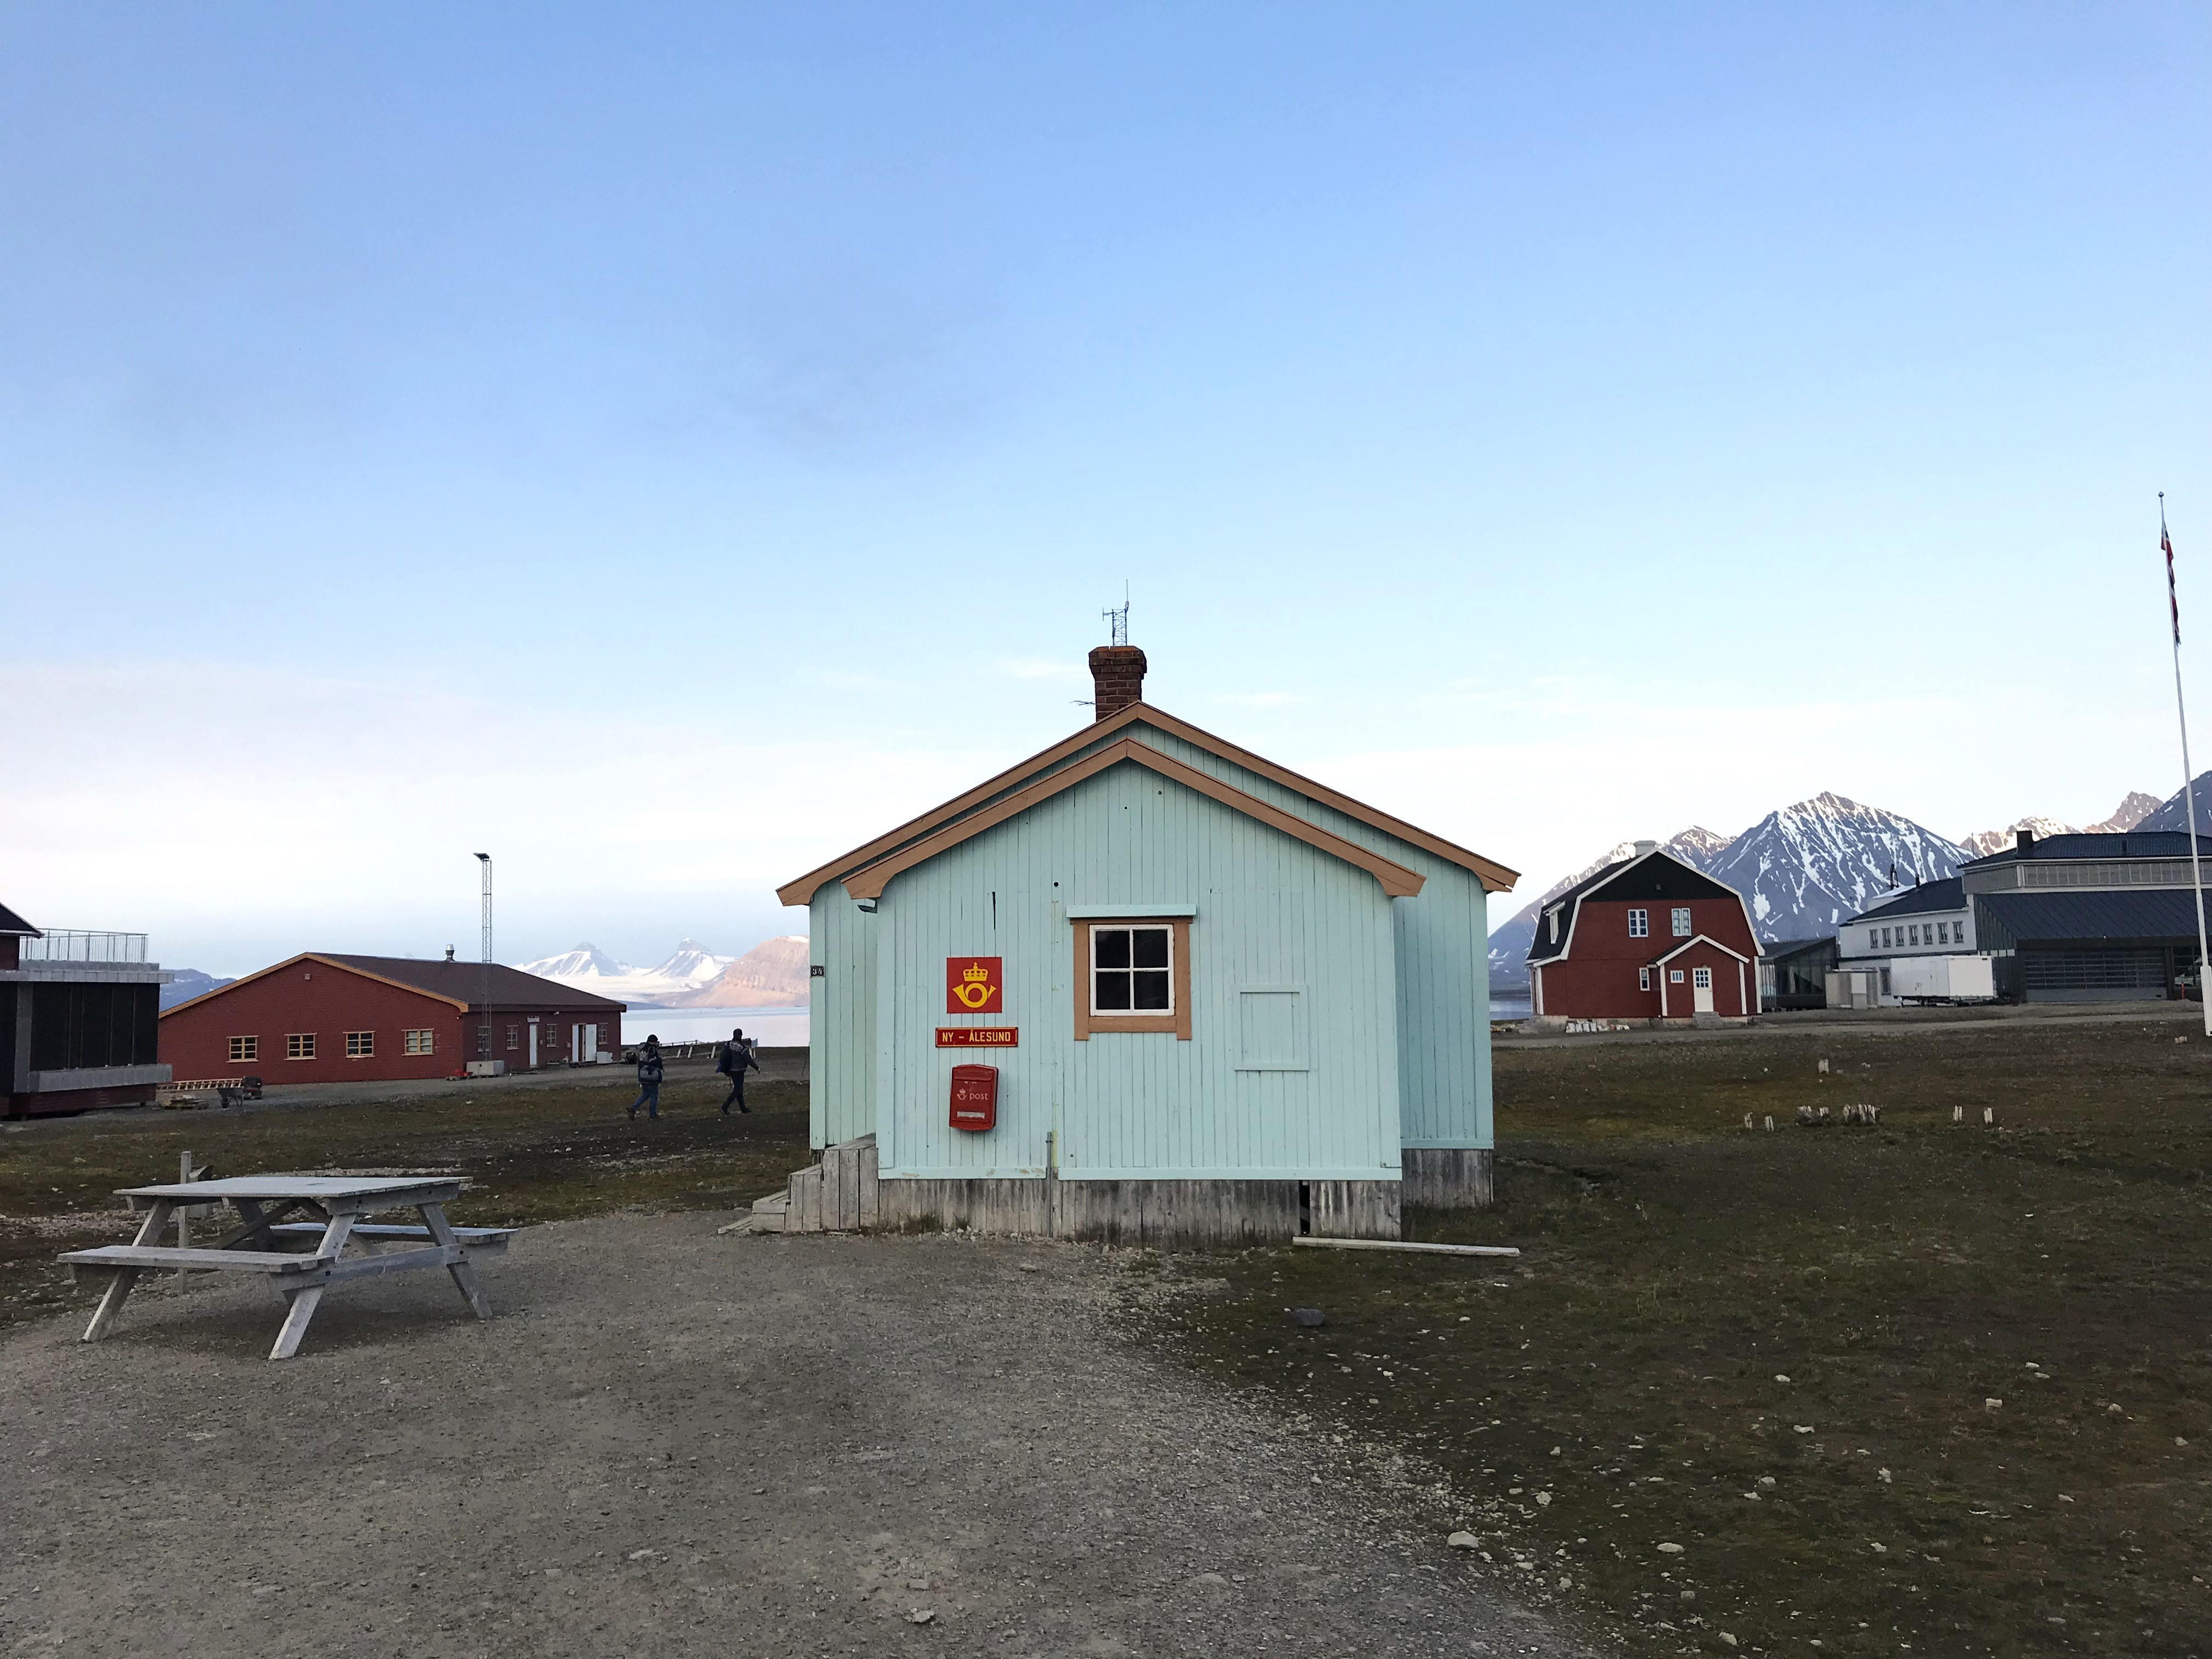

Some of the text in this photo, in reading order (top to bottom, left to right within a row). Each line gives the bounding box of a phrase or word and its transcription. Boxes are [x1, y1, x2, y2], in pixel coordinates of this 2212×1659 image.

[942, 1032, 953, 1042] NY
[969, 1029, 1011, 1042] ÅLESUND
[969, 1093, 988, 1101] post
